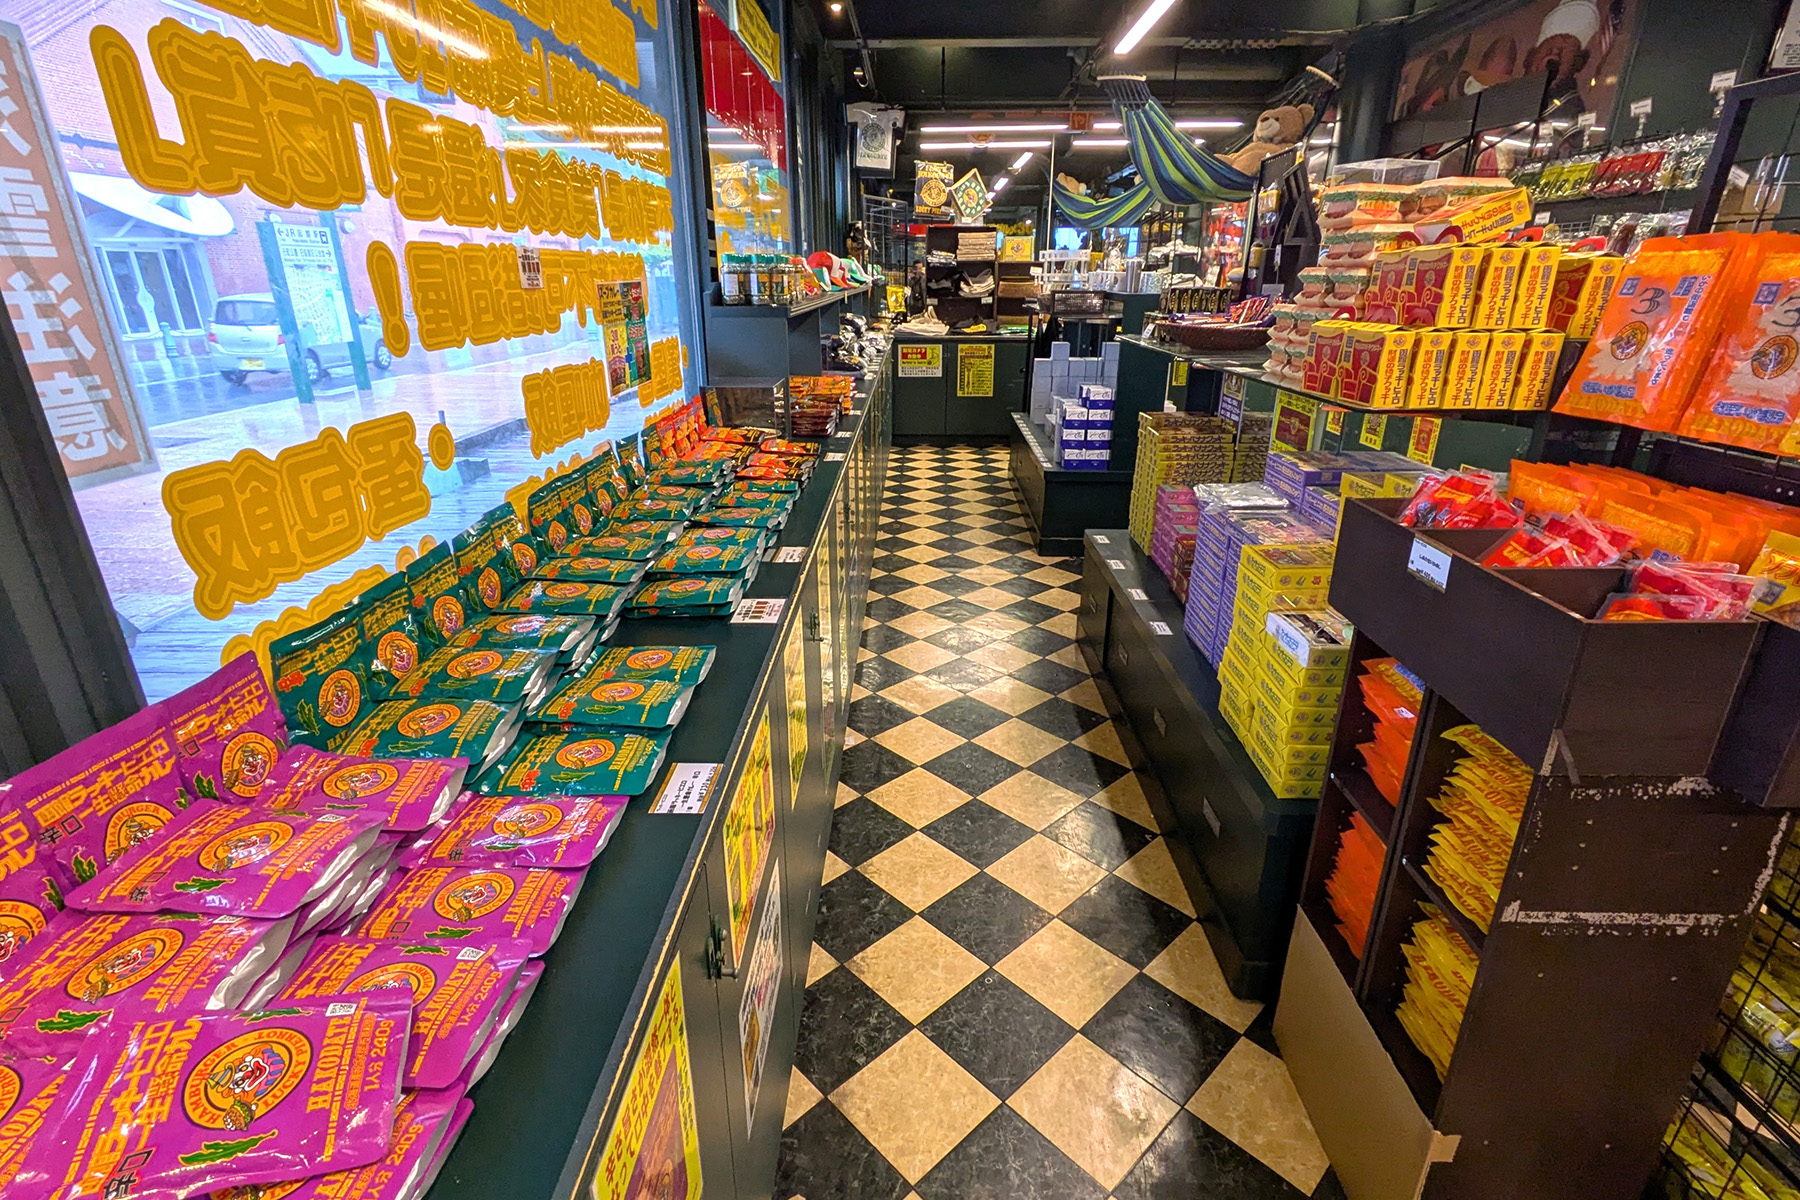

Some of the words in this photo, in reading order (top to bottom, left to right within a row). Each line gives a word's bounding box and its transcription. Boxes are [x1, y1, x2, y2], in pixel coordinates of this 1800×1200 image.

[33, 738, 170, 827] 函館ラッキーピエロ
[371, 1019, 396, 1057] 240g
[413, 960, 474, 1034] HAKODATE
[187, 1041, 239, 1125] HAMBURGER
[262, 1059, 306, 1110] LUCKY
[306, 1015, 352, 1113] HAKODATE
[76, 1019, 176, 1196] 函館ラッキーピエロ
